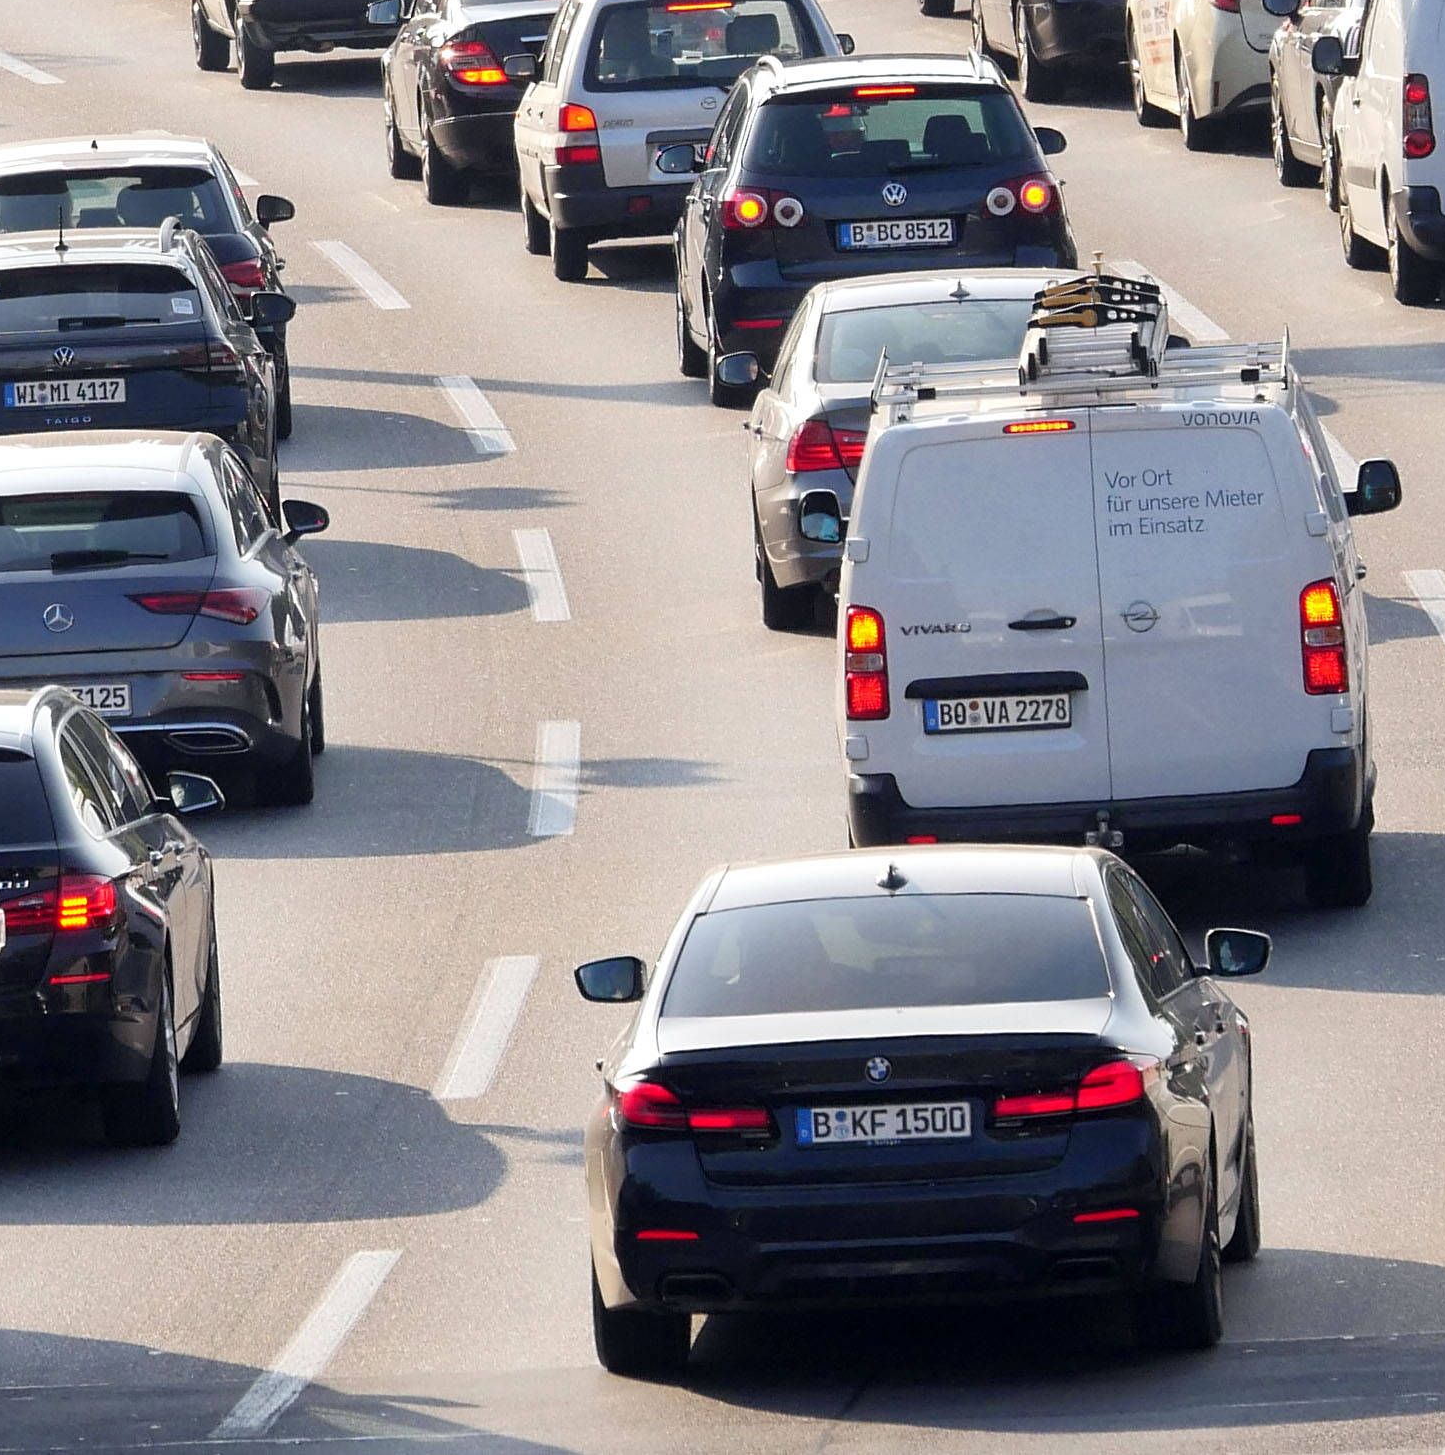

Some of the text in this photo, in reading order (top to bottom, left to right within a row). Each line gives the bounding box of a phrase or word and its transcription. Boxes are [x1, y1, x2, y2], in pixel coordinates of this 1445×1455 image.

[853, 221, 950, 242] B BC 8512
[16, 381, 120, 403] WI MI 4117
[1105, 469, 1173, 489] Vor Ort
[1107, 489, 1265, 513] für unsere Mieter
[1109, 516, 1206, 536] im Einsatz
[900, 622, 972, 636] VIVARO
[984, 700, 1010, 724] VA
[1016, 698, 1067, 722] 2278
[813, 1106, 966, 1138] B KF 1500
